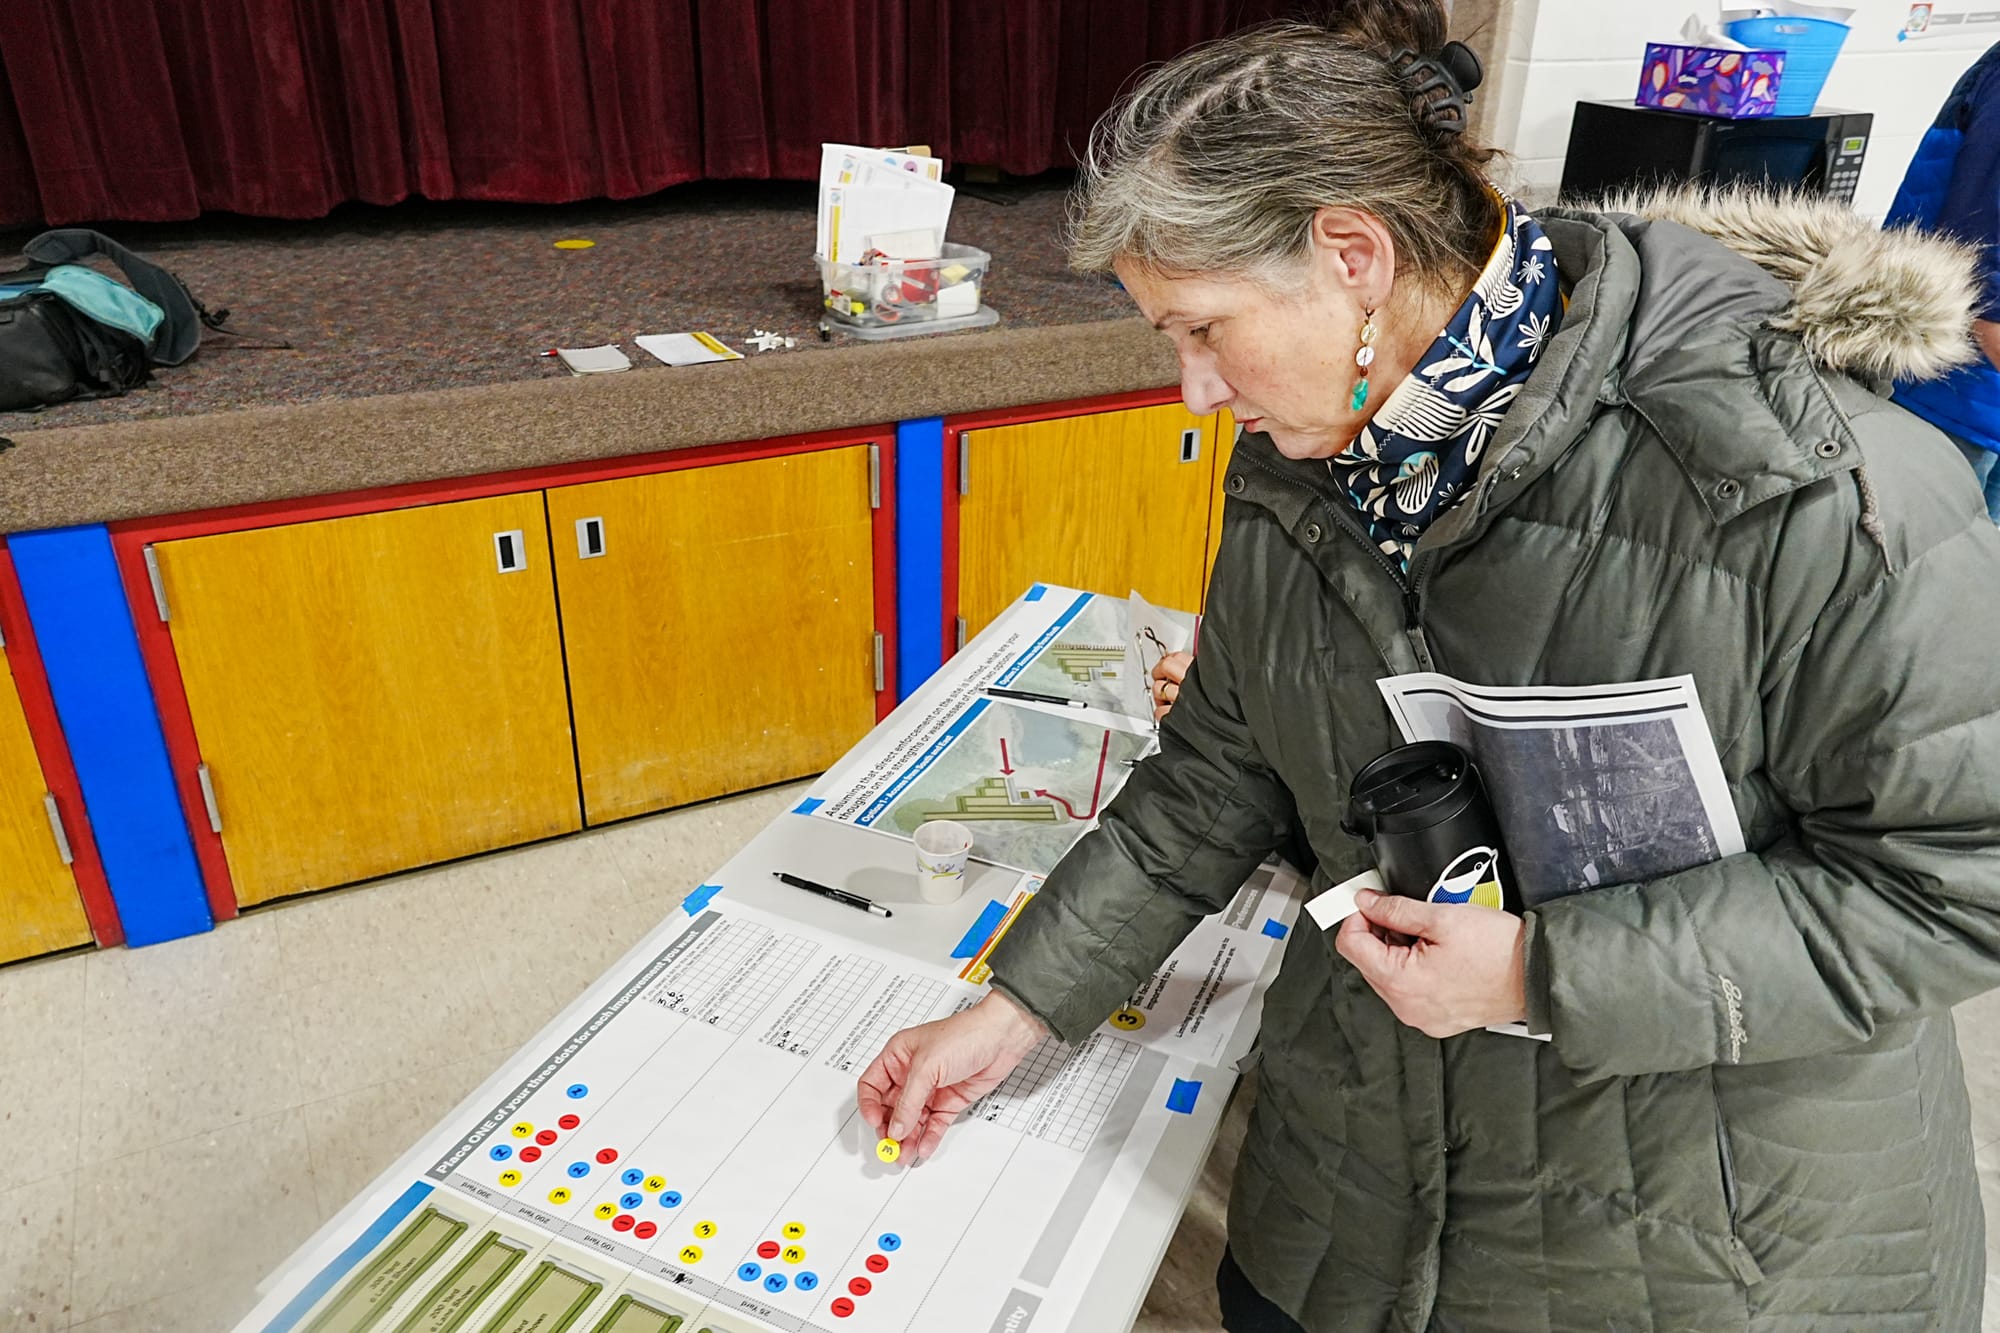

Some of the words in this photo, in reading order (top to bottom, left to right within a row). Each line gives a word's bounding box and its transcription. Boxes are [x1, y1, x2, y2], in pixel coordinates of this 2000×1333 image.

[999, 670, 1016, 685] Option
[825, 784, 865, 817] Assuming
[860, 770, 878, 784] that
[875, 751, 898, 770] direct
[895, 715, 936, 751] enforcement
[932, 707, 944, 715] on
[939, 698, 953, 708] the
[950, 688, 964, 698] site
[986, 652, 1001, 664] what
[998, 644, 1010, 652] are
[1006, 633, 1020, 644] your
[838, 791, 874, 820] thoughts
[871, 782, 883, 790] on
[878, 771, 894, 781] the
[891, 742, 924, 770] strengths
[921, 734, 931, 742] or
[929, 702, 965, 734] weaknesses
[982, 671, 996, 680] two
[861, 801, 884, 822] Option
[886, 778, 908, 798] Access
[903, 768, 919, 782] from
[915, 755, 933, 771] South
[931, 745, 941, 756] and
[1232, 890, 1258, 929] Preference
[1144, 979, 1167, 1010] important
[1176, 1015, 1192, 1038] Limiting
[1188, 1005, 1197, 1016] you
[1195, 986, 1206, 1000] three
[1201, 967, 1216, 986] choices
[1213, 950, 1224, 967] allows
[1191, 1015, 1204, 1034] clearly
[1200, 1005, 1208, 1014] see
[1205, 992, 1214, 1005] what
[1211, 981, 1220, 993] your
[1217, 957, 1231, 982] priorities
[1117, 1013, 1137, 1025] 3
[1131, 995, 1144, 1006] the
[436, 1145, 472, 1174] Place
[468, 1120, 497, 1144] ONE
[494, 1109, 508, 1121] of
[506, 1088, 530, 1111] your
[527, 1064, 556, 1088] three
[554, 1044, 578, 1064] dots
[573, 1031, 591, 1044] for
[589, 1011, 613, 1031] each
[609, 962, 665, 1011] improvement
[662, 948, 680, 963] you
[676, 931, 699, 948] want
[460, 1182, 477, 1192] Yard
[476, 1189, 491, 1199] 300
[518, 1208, 535, 1218] Yard
[534, 1214, 550, 1224] 200
[584, 1235, 600, 1246] Yard
[600, 1242, 615, 1252] 100
[383, 1261, 400, 1275] Yard
[660, 1267, 677, 1278] Yard
[429, 1304, 445, 1319] 200
[442, 1288, 460, 1303] Yard
[435, 1308, 454, 1326] Lane
[452, 1285, 476, 1307] Shown
[740, 1301, 758, 1312] Yard
[759, 1308, 771, 1317] 25
